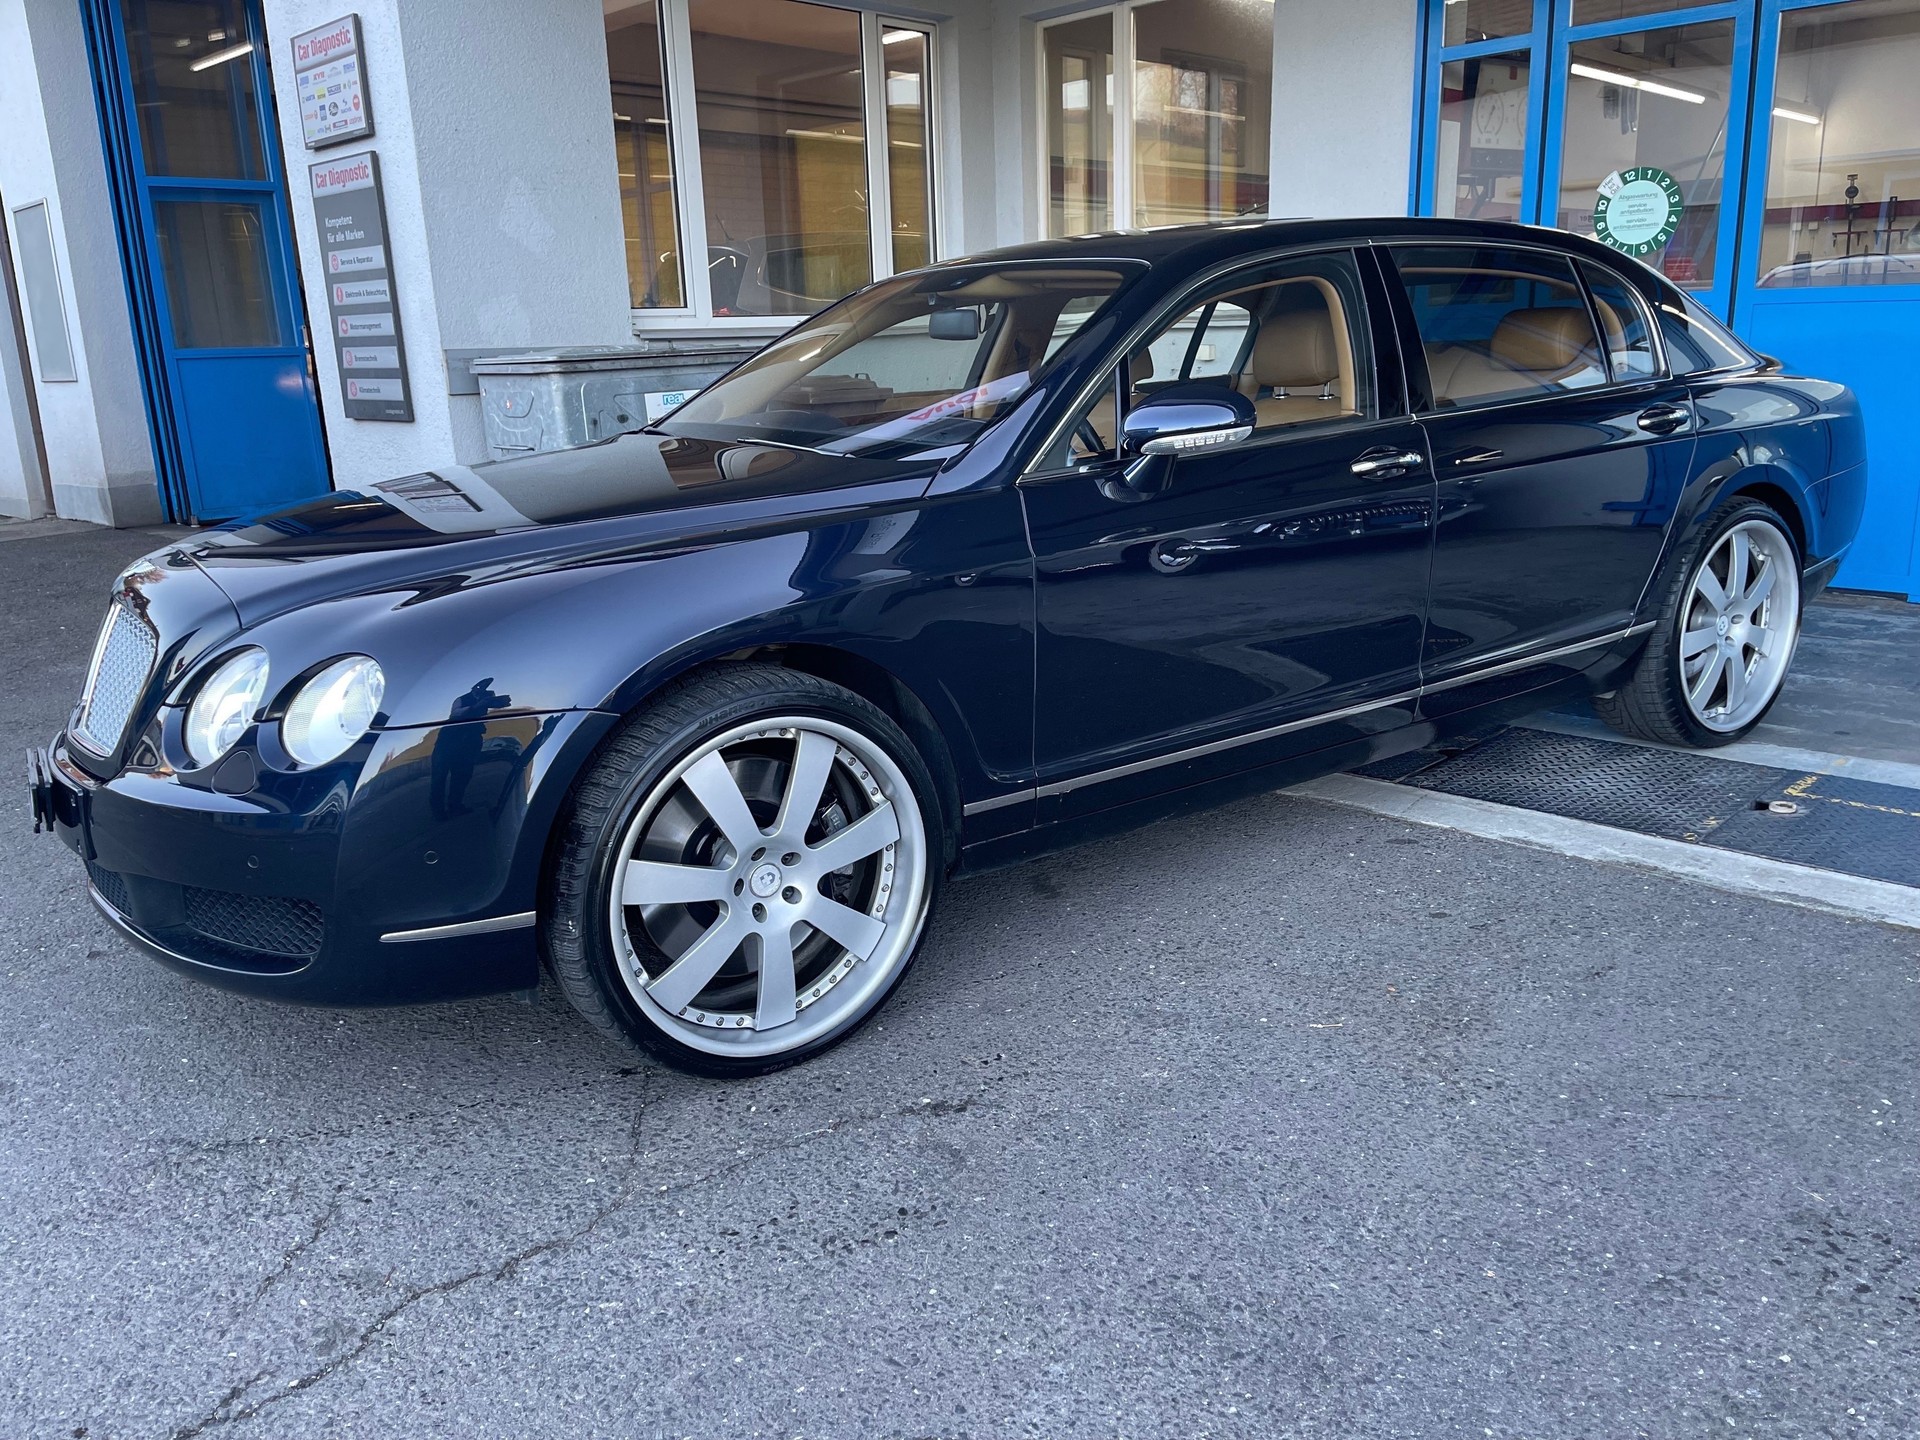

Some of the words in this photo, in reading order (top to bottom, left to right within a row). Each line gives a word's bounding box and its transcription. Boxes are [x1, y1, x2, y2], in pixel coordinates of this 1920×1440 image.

[297, 42, 310, 61] Car
[310, 26, 351, 57] Diagnostic
[315, 173, 328, 189] Car
[328, 161, 369, 188] Diagnostic
[1624, 171, 1636, 182] 12
[1646, 169, 1653, 179] 1
[1661, 178, 1671, 188] 2
[1618, 191, 1659, 201] Abgaswartung
[1669, 195, 1680, 204] 3
[1597, 199, 1608, 212] 10
[1620, 207, 1655, 215] antipollution
[325, 215, 353, 229] Kompetenz
[1668, 215, 1678, 223] 4
[1596, 222, 1606, 230] 9
[327, 233, 335, 243] für
[335, 231, 345, 242] alle
[345, 229, 365, 241] Marken
[1657, 232, 1667, 242] 5
[1639, 244, 1648, 254] 6
